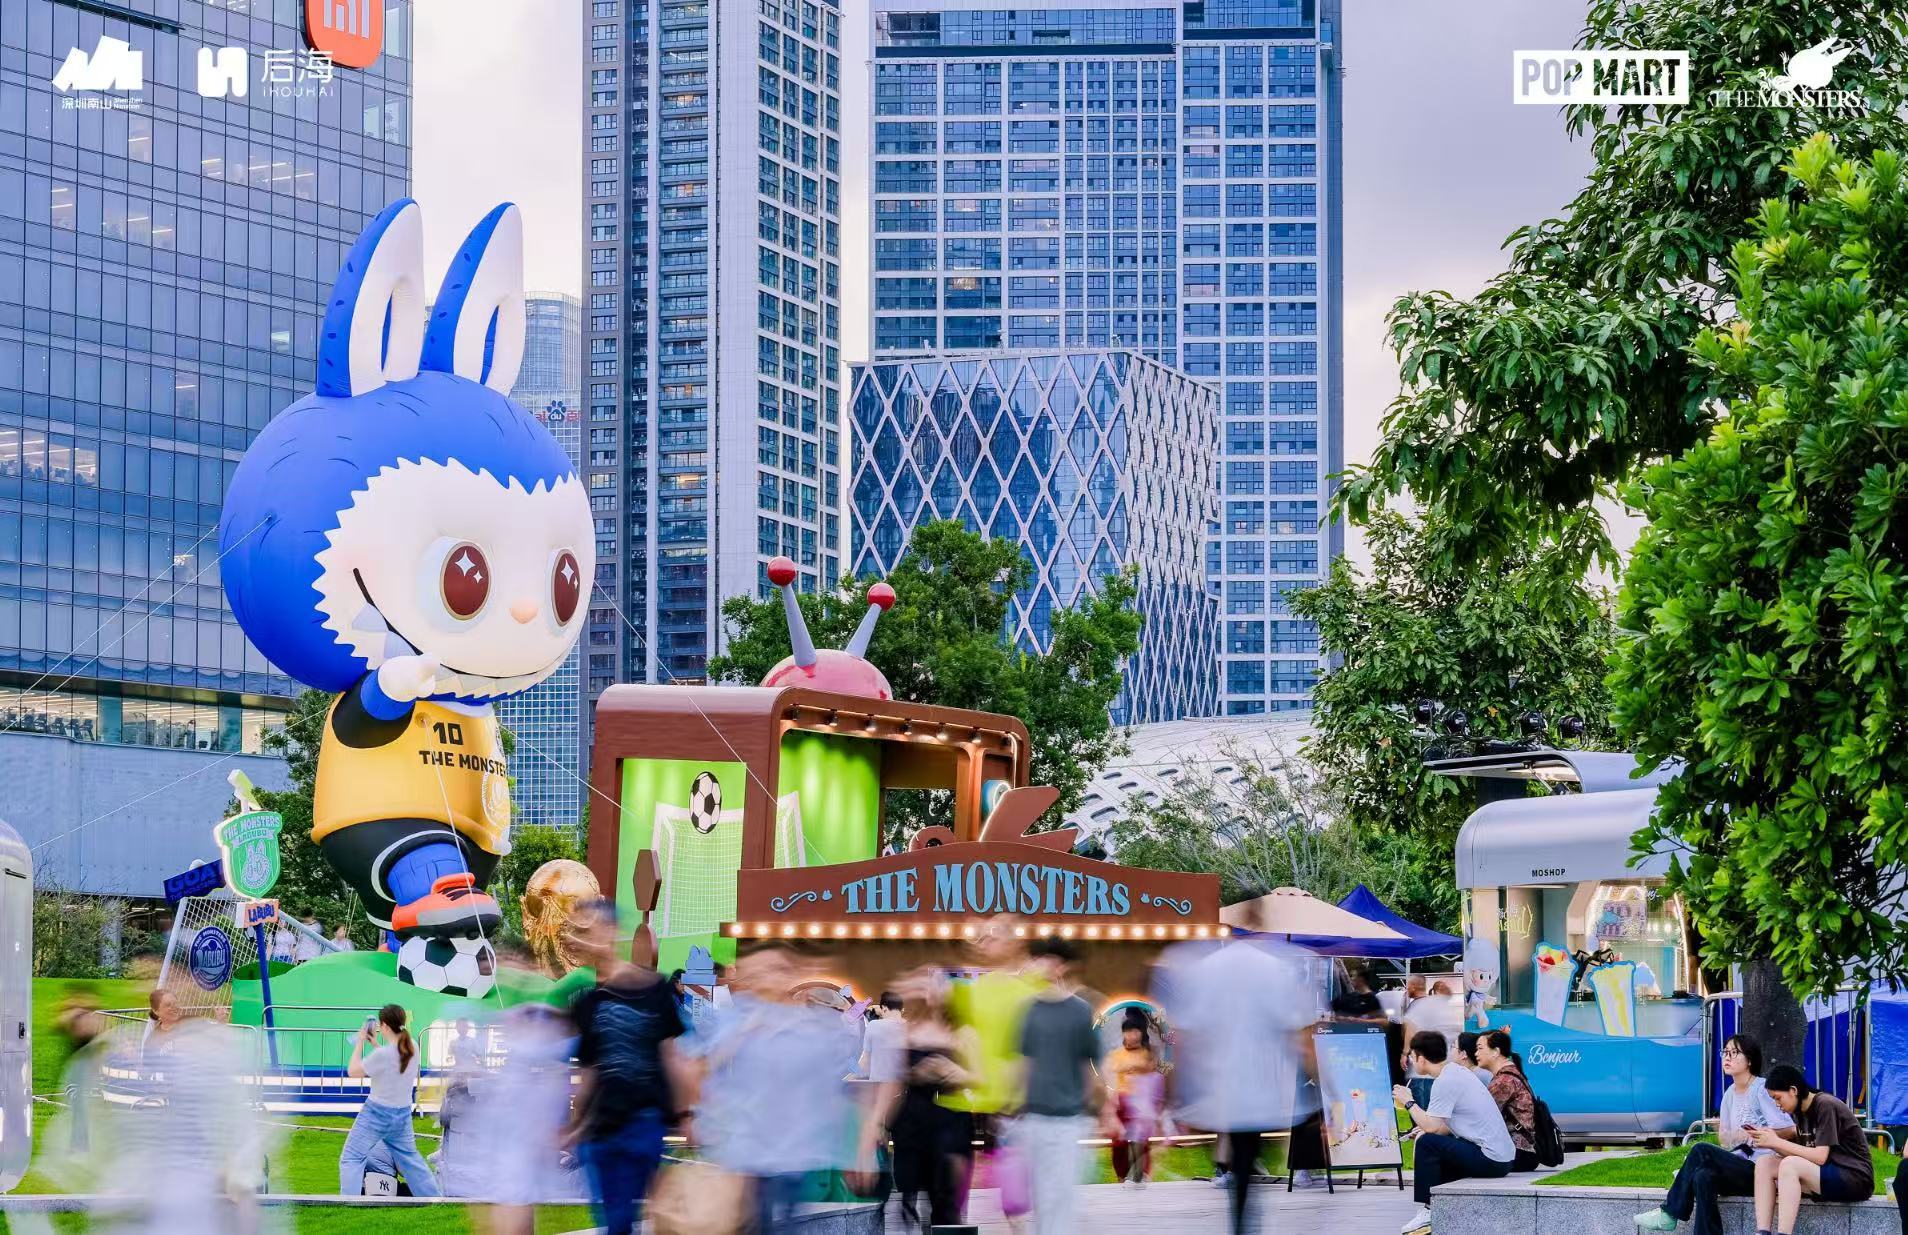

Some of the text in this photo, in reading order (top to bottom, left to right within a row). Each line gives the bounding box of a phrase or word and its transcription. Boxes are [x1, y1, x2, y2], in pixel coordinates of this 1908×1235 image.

[433, 722, 464, 745] 10
[419, 751, 454, 767] THE
[1531, 868, 1566, 877] MOSHOP
[841, 861, 1131, 916] THE MONSTERS
[1528, 1044, 1581, 1068] Bonjour
